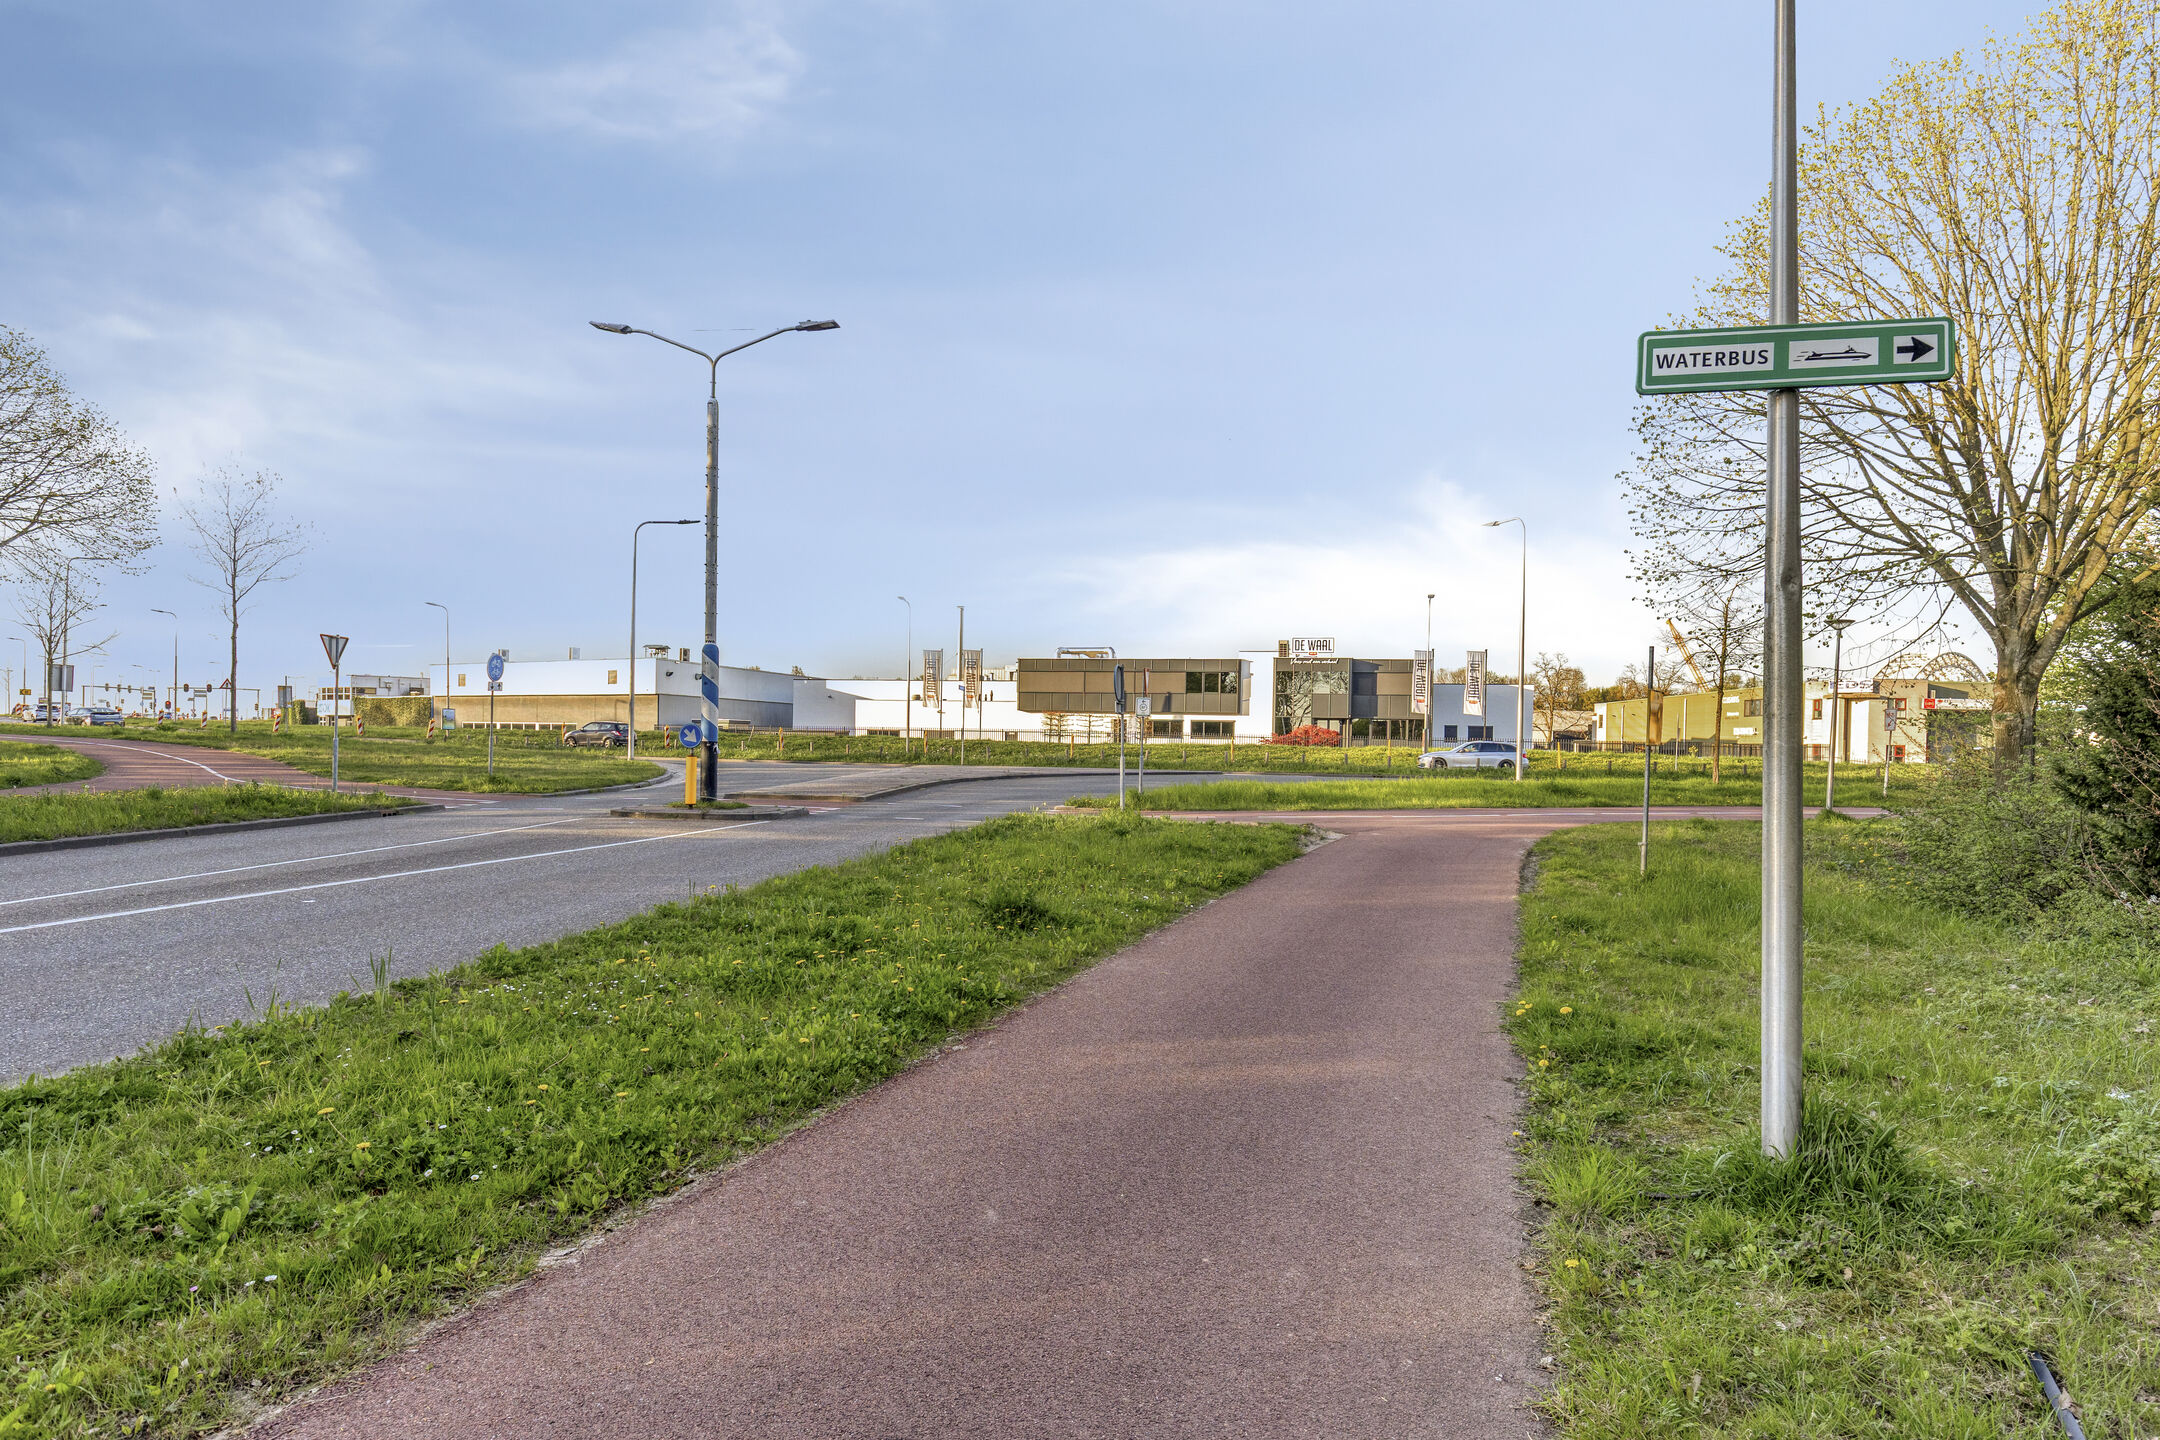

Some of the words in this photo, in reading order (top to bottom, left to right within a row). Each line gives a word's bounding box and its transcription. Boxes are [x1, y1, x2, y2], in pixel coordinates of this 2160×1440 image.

[1656, 349, 1769, 369] WATERBUS
[1295, 640, 1305, 651] DE
[1308, 640, 1332, 651] WAAL
